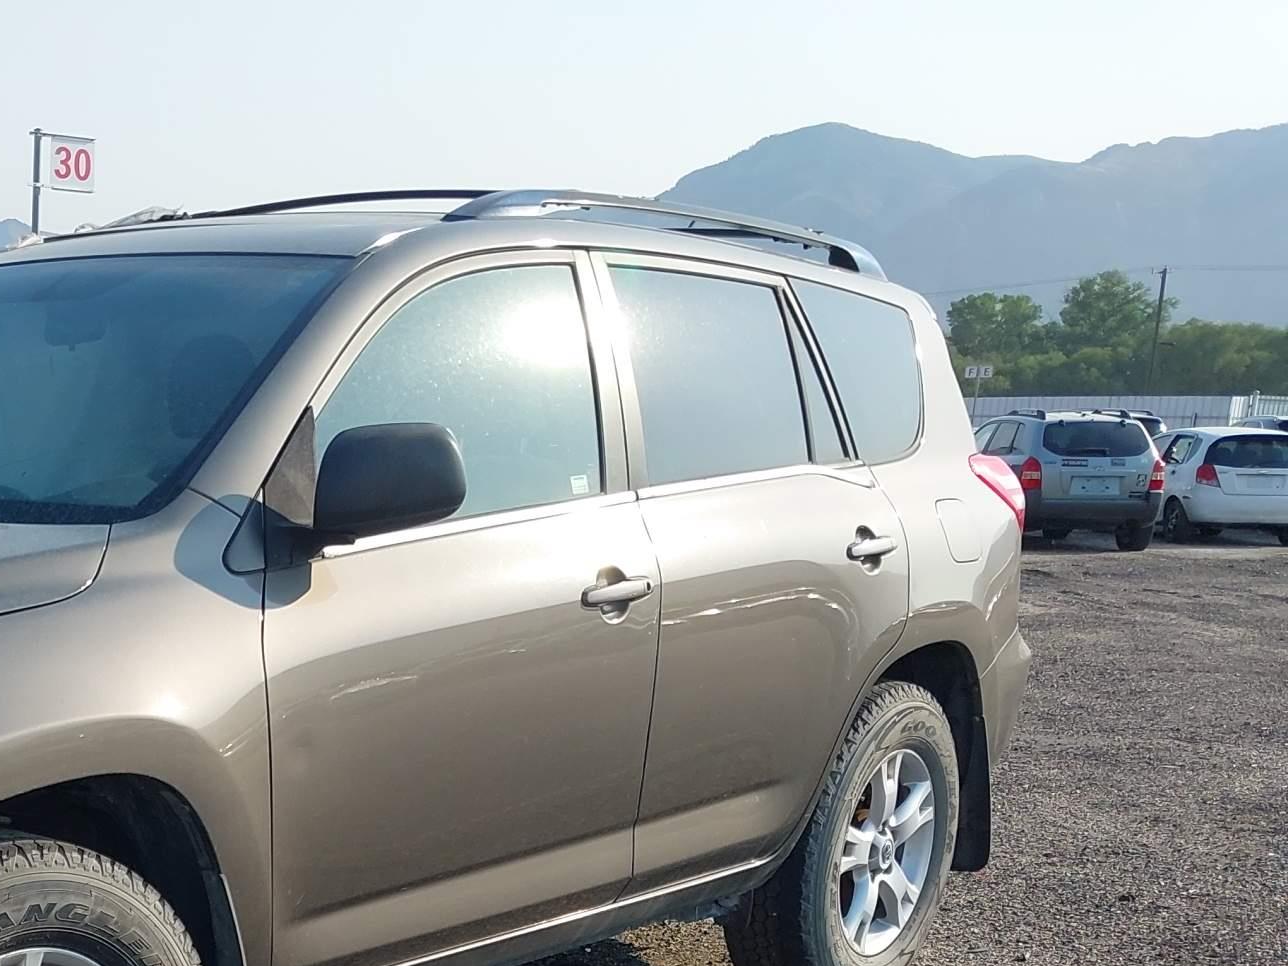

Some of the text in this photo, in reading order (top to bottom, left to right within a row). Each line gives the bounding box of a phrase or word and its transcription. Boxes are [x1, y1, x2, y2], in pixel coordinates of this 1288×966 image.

[54, 146, 91, 181] 30
[968, 367, 977, 377] F
[983, 367, 991, 377] E
